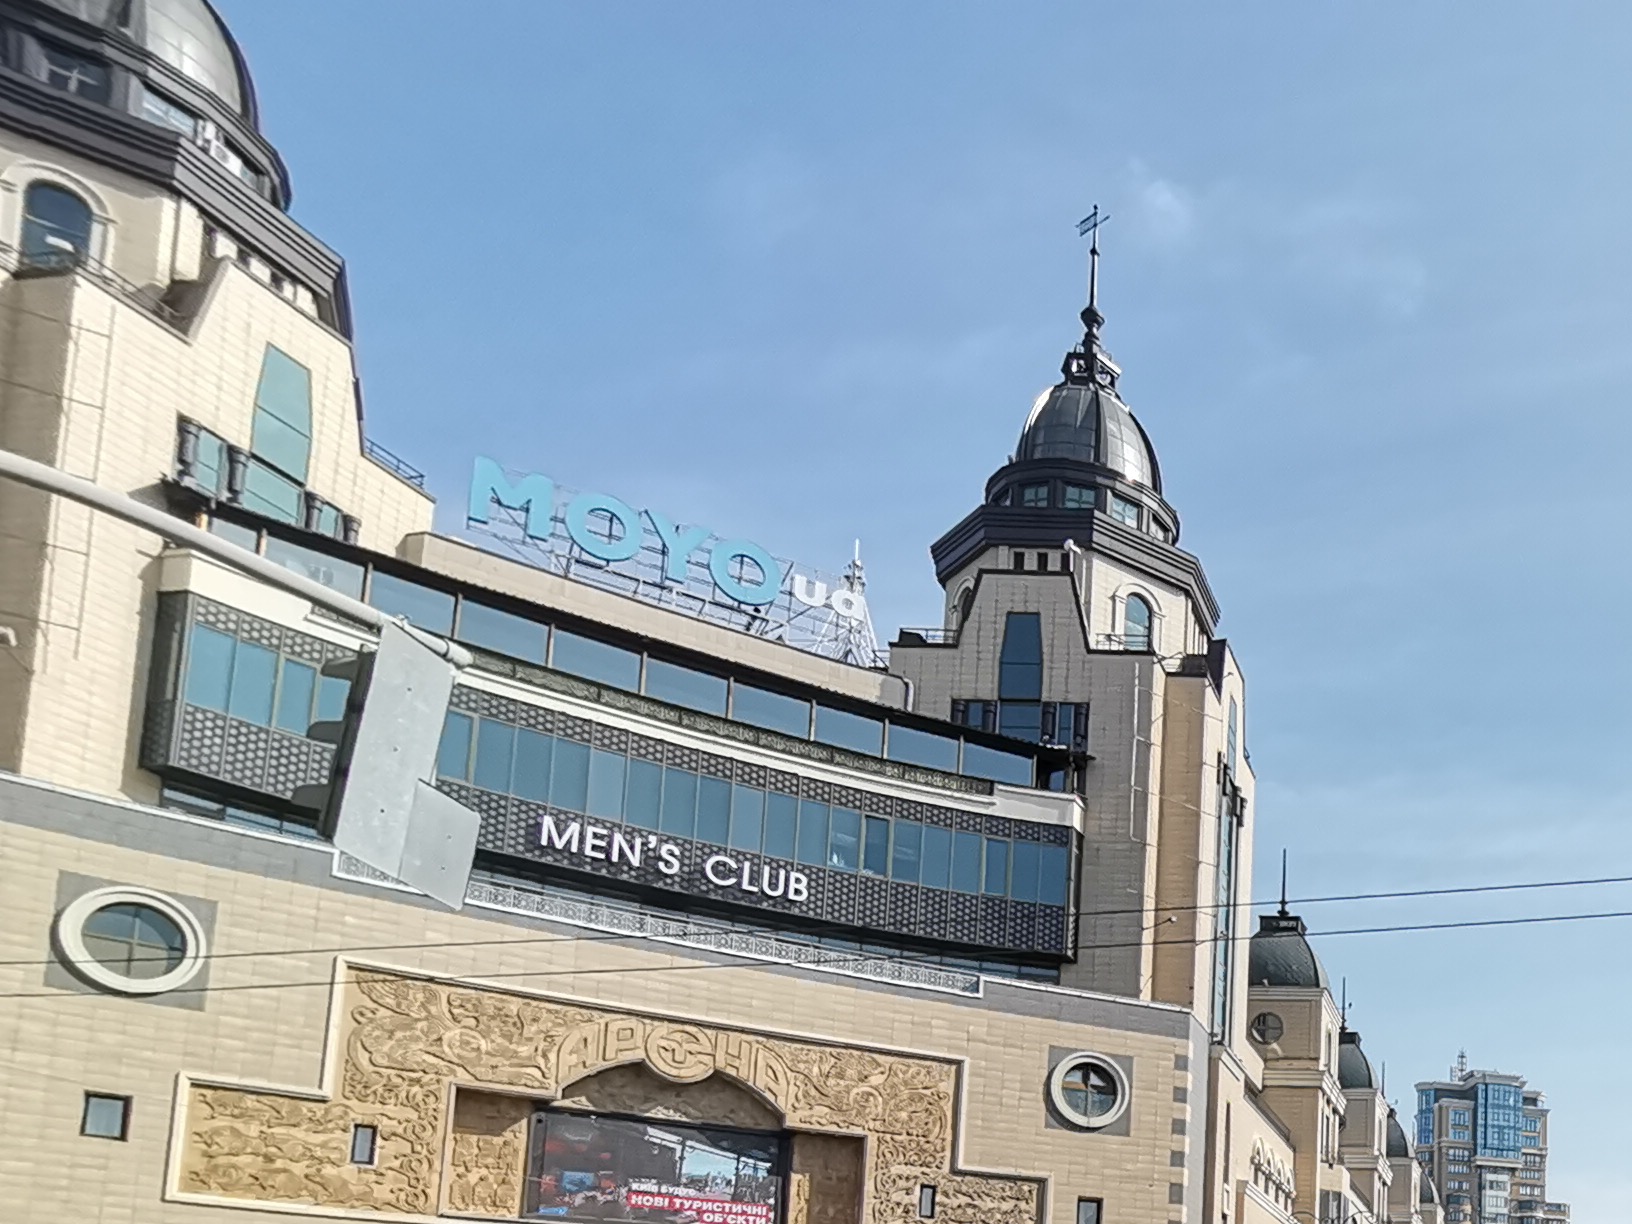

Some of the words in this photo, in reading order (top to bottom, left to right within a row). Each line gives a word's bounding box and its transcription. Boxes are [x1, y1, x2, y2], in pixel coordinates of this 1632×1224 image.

[468, 455, 782, 606] MOYO
[540, 815, 681, 875] MEN'S
[704, 855, 809, 901] CLUB
[630, 1194, 669, 1208] НОВІ
[672, 1198, 768, 1216] ТУРИСТИЧНІ
